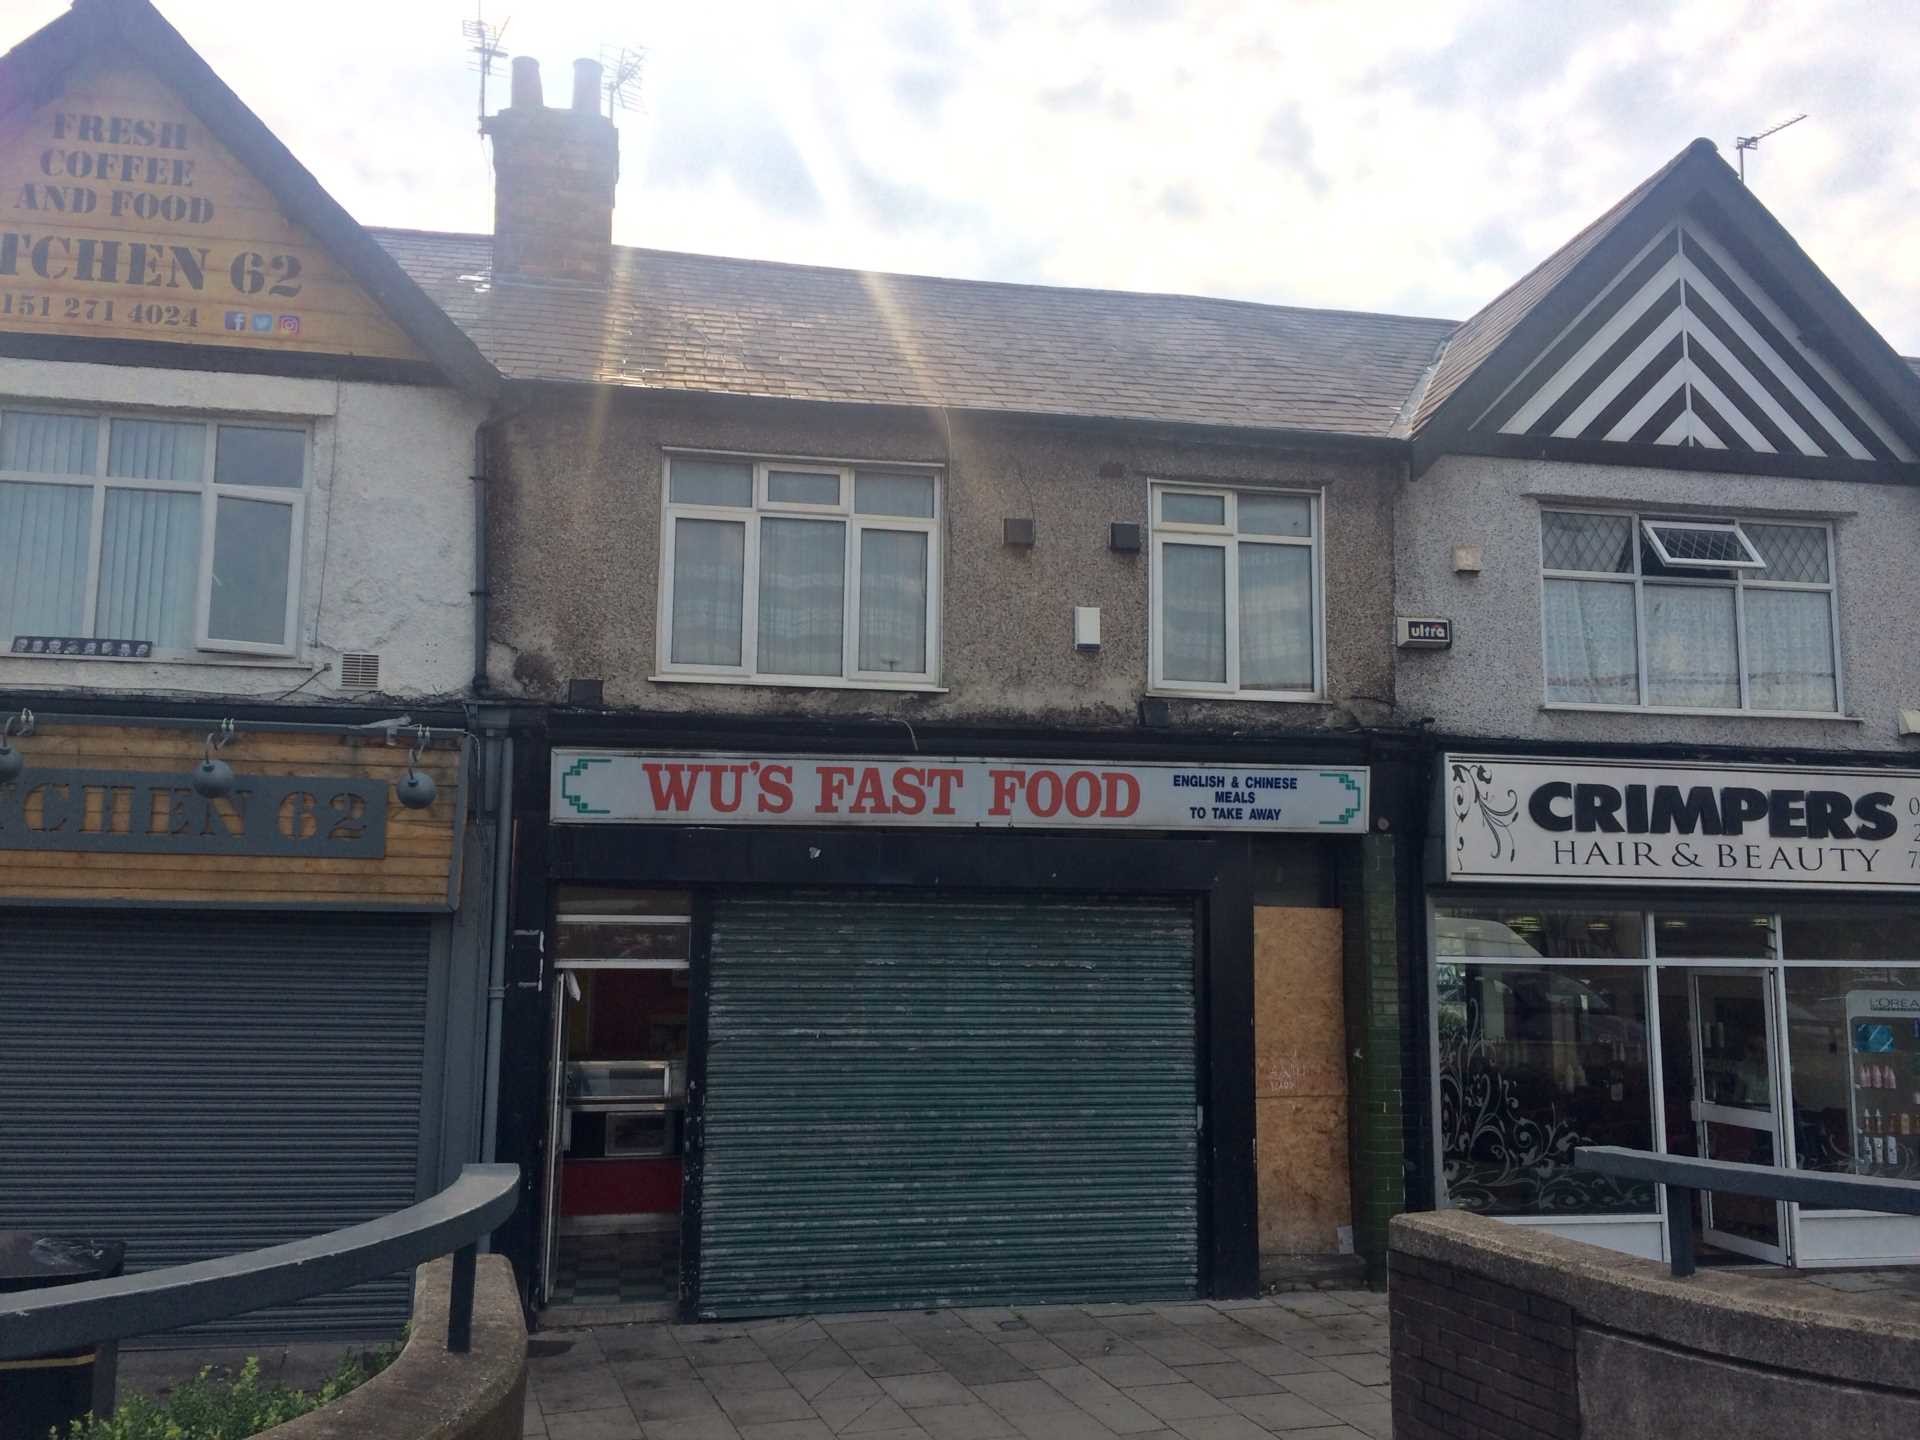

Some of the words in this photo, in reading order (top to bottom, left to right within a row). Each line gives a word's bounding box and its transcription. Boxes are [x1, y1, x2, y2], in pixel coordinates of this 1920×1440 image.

[53, 113, 188, 150] FRESH
[39, 149, 195, 187] COFFEE
[13, 183, 97, 214] AND
[109, 190, 215, 225] FOOD
[230, 251, 303, 298] 62
[64, 297, 114, 322] 271
[128, 304, 199, 328] 4024
[1411, 624, 1446, 638] ultra
[642, 761, 794, 814] WU'S
[815, 766, 964, 815] FAST
[988, 769, 1141, 818] FOOD
[1173, 774, 1226, 789] ENGLISH
[1231, 776, 1240, 789] &
[1245, 775, 1298, 790] CHINESE
[1214, 791, 1256, 804] MEALS
[277, 791, 368, 840] 62
[1189, 806, 1207, 820] TO
[1212, 807, 1245, 821] TAKE
[1249, 808, 1282, 822] AWAY
[1528, 781, 1898, 841] CRIMPERS
[1553, 840, 1661, 866] HAIR
[1670, 842, 1703, 868] &
[1717, 844, 1880, 872] BEAUTY
